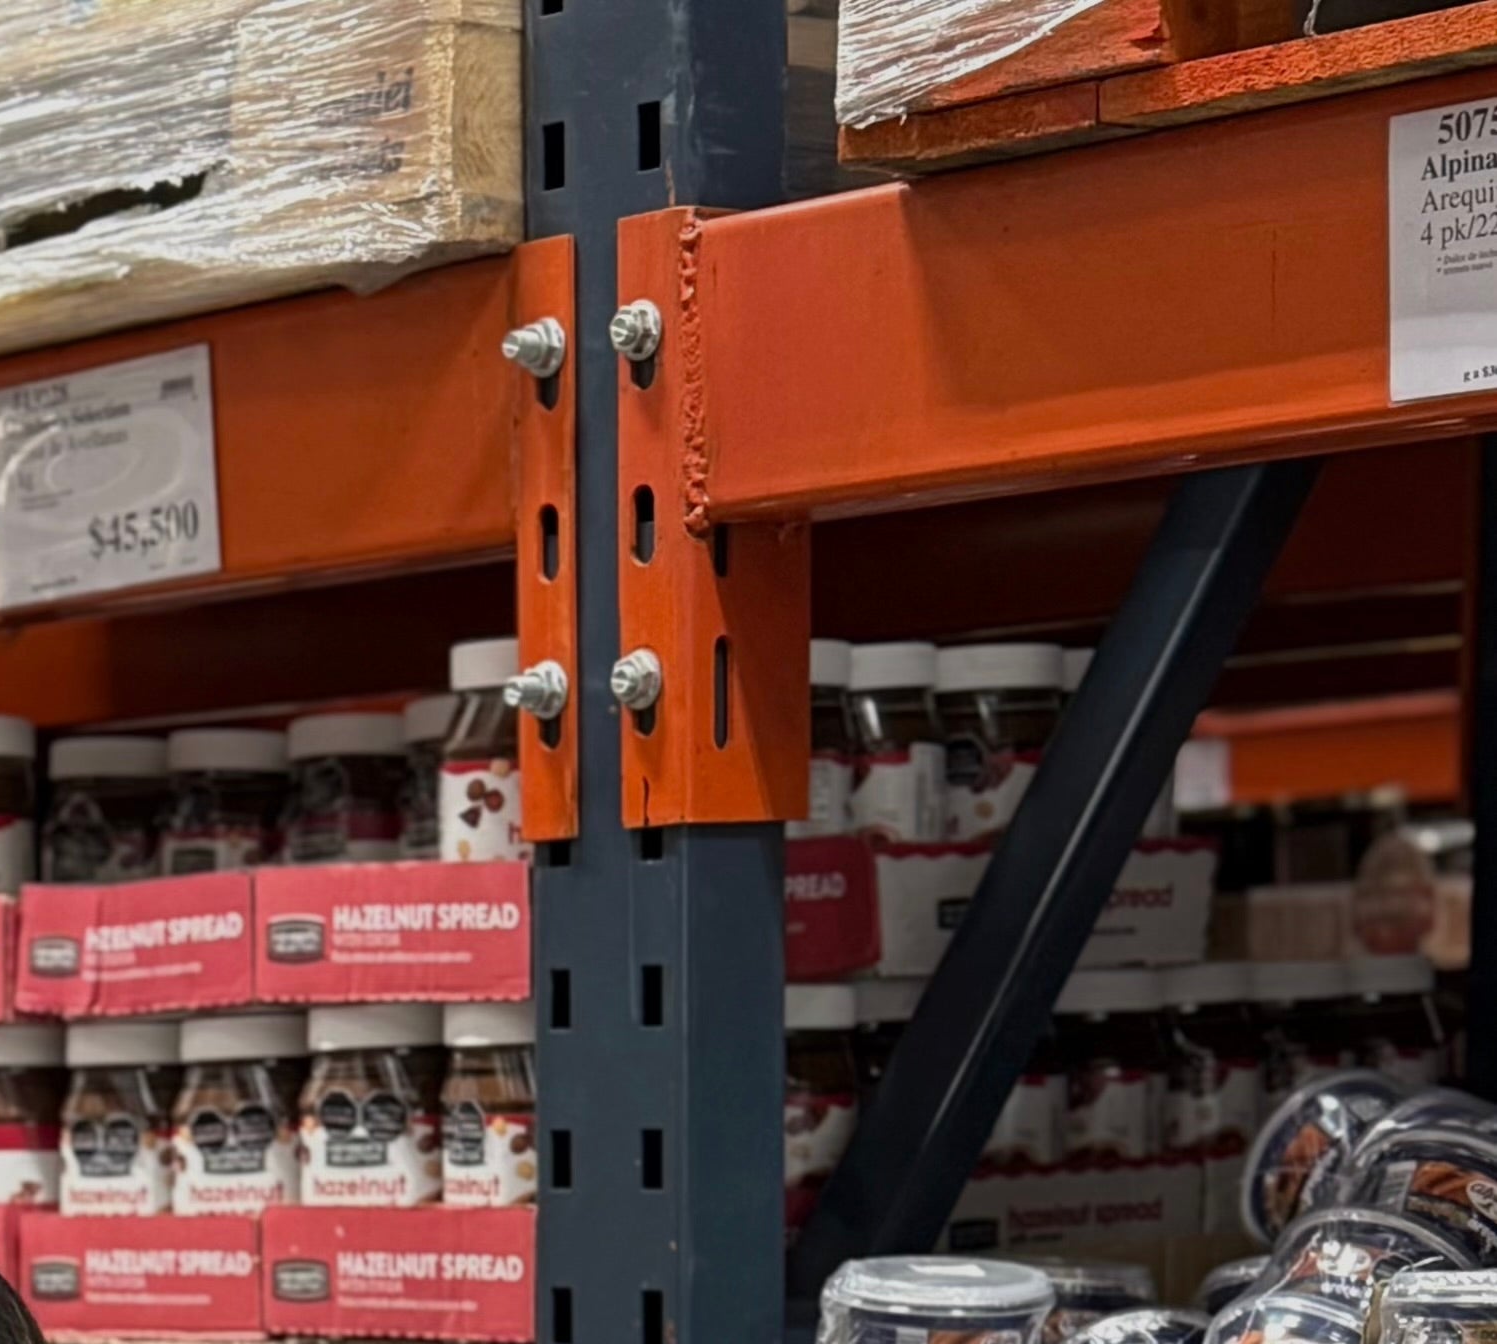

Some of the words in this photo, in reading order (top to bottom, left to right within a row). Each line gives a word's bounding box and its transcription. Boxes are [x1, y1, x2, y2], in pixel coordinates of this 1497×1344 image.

[1420, 151, 1497, 184] Alpina
[1420, 179, 1497, 214] Arequi
[1419, 222, 1433, 246] 4
[88, 500, 200, 560] $45,500
[1110, 884, 1174, 911] pread
[169, 911, 244, 945] SPREAD
[333, 905, 435, 931] HAZELNUT
[437, 902, 520, 930] SPREAD
[85, 1251, 175, 1275] HAZELNUT
[176, 1249, 252, 1276] SPREAD
[336, 1252, 439, 1279] HAZELNUT
[442, 1254, 524, 1281] SPREAD
